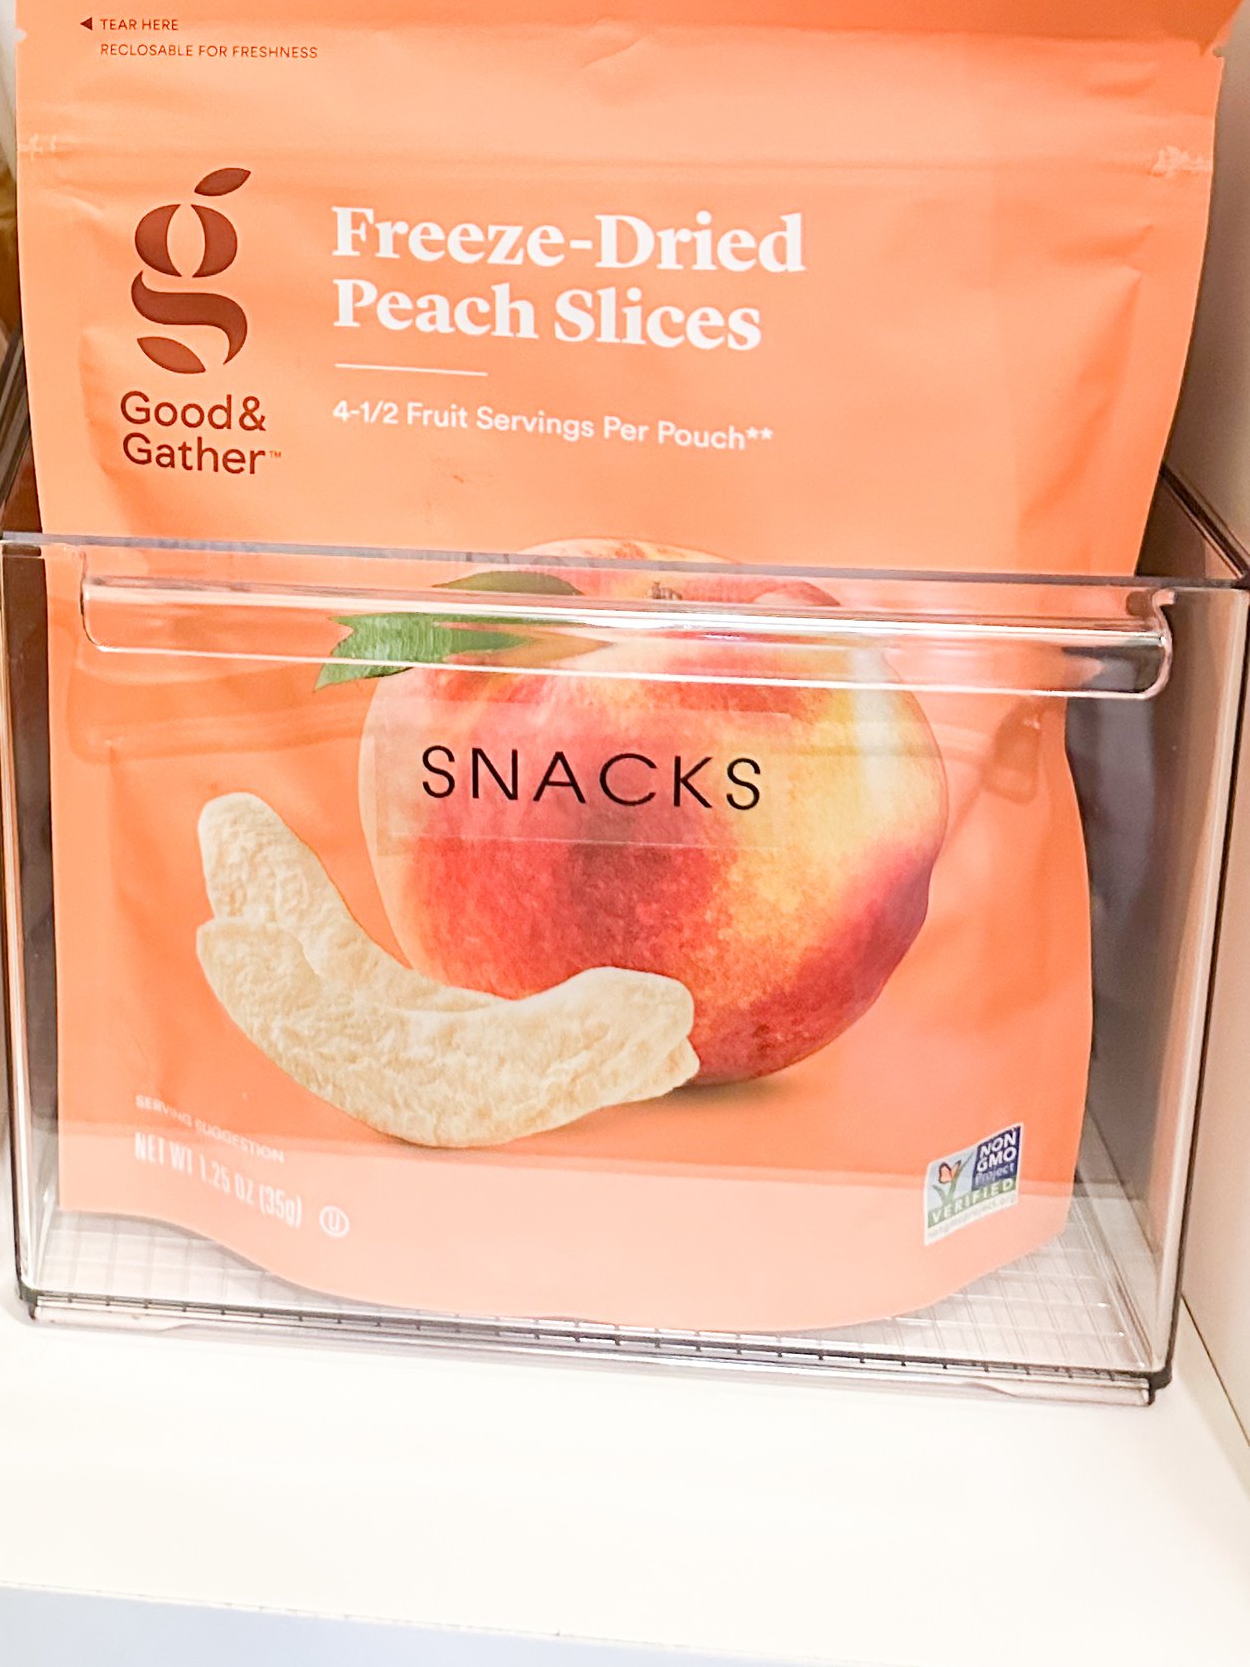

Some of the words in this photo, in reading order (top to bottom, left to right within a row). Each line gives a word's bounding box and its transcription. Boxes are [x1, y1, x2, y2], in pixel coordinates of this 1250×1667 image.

[100, 19, 137, 31] TEAR
[142, 19, 179, 31] HERE
[100, 43, 193, 57] RECLOSABLE
[199, 45, 227, 57] FOR
[232, 46, 318, 59] FRESHNESS
[331, 208, 806, 273] Freeze-Dried
[332, 278, 539, 339] Peach
[554, 286, 762, 351] Slices
[333, 400, 399, 424] 4-1/2
[407, 402, 468, 429] Fruit
[476, 406, 596, 442] Servings
[604, 416, 648, 441] Per
[421, 744, 763, 811] SNACKS
[135, 1094, 192, 1127] SERVING
[194, 1118, 284, 1163] SUGGESTION
[980, 1131, 1016, 1158] NON
[135, 1132, 165, 1166] NET
[169, 1140, 193, 1175] WT
[200, 1154, 230, 1193] 1.25
[259, 1182, 302, 1229] (35g)
[976, 1147, 1017, 1172] GMO
[932, 1178, 1014, 1223] VERIFIED
